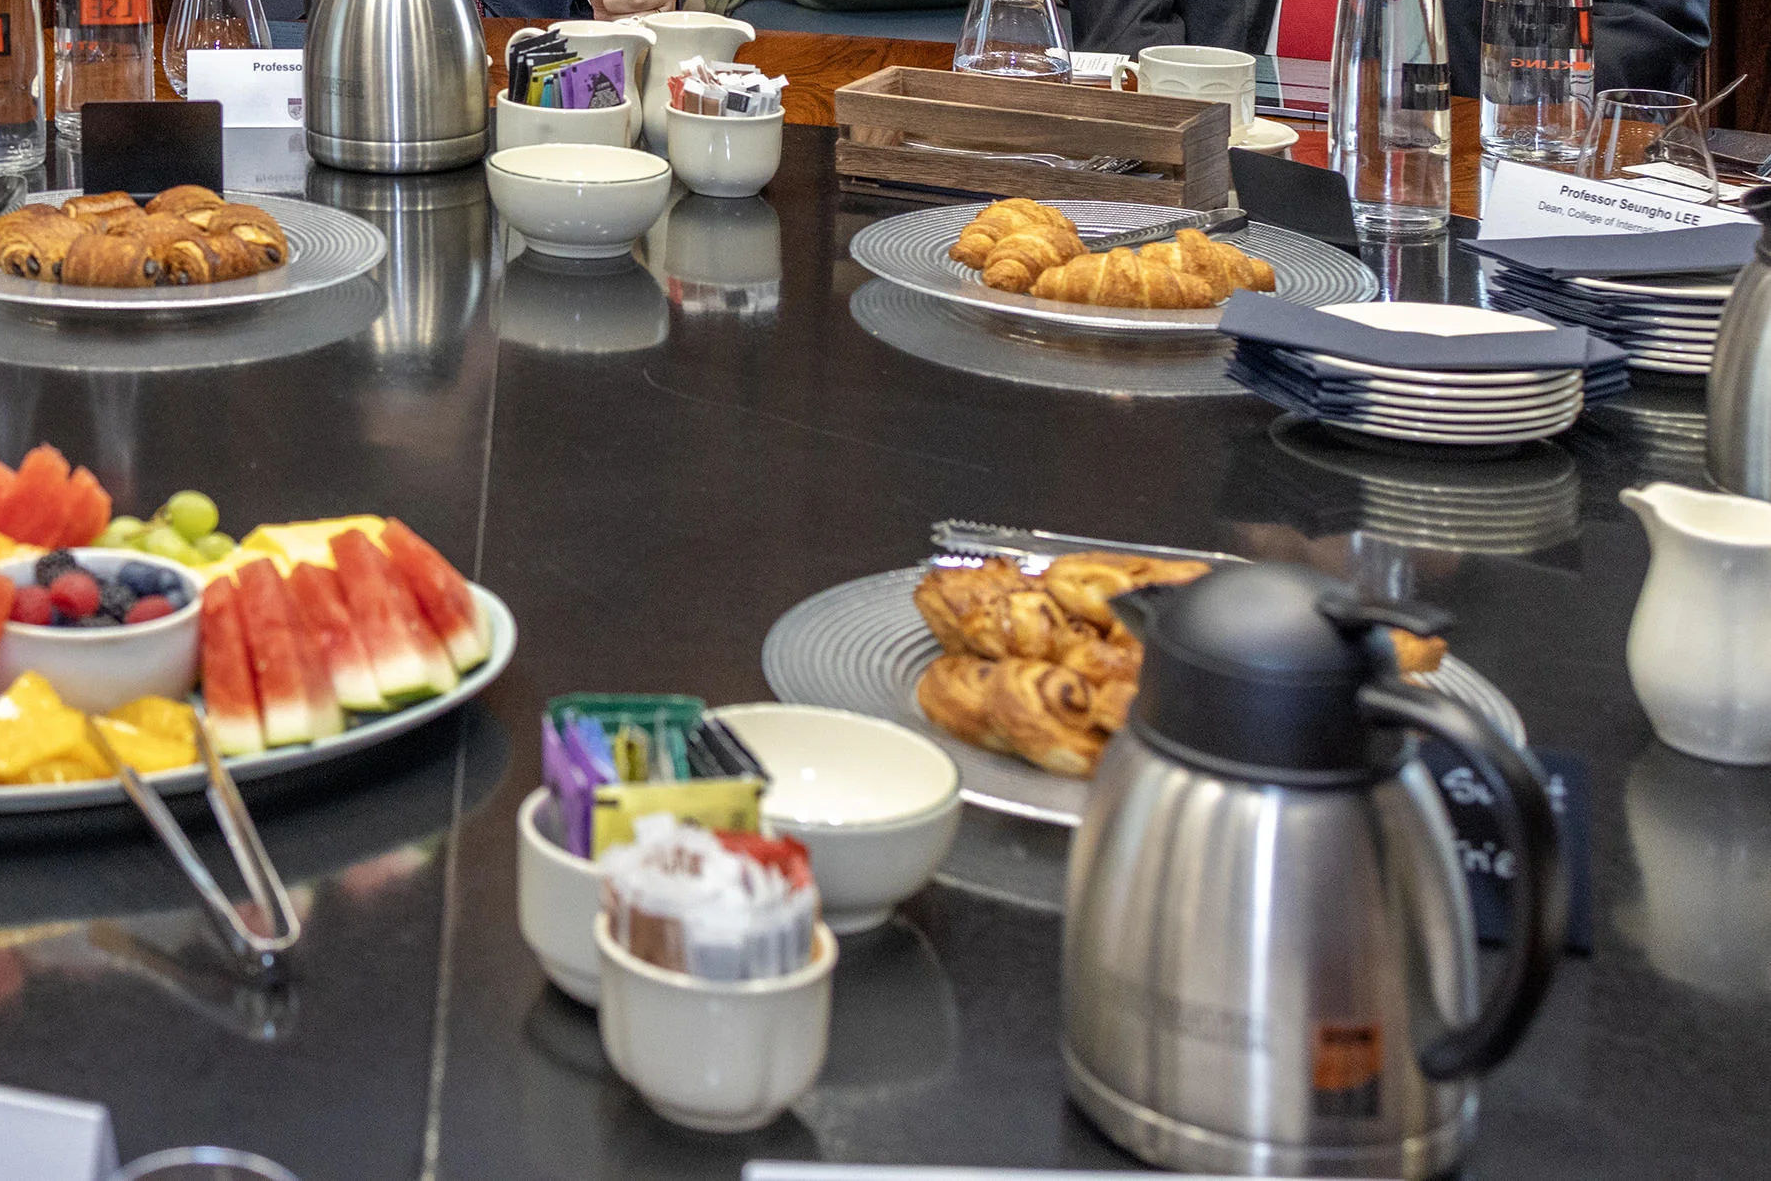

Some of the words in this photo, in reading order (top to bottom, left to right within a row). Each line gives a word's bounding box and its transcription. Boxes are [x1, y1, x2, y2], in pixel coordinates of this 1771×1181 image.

[253, 62, 303, 72] Professo
[1538, 200, 1565, 216] Dean,
[1567, 207, 1603, 225] College
[1604, 216, 1615, 226] of
[1559, 185, 1617, 207] Professor
[1619, 198, 1673, 220] Seungho
[1675, 211, 1701, 226] LEE
